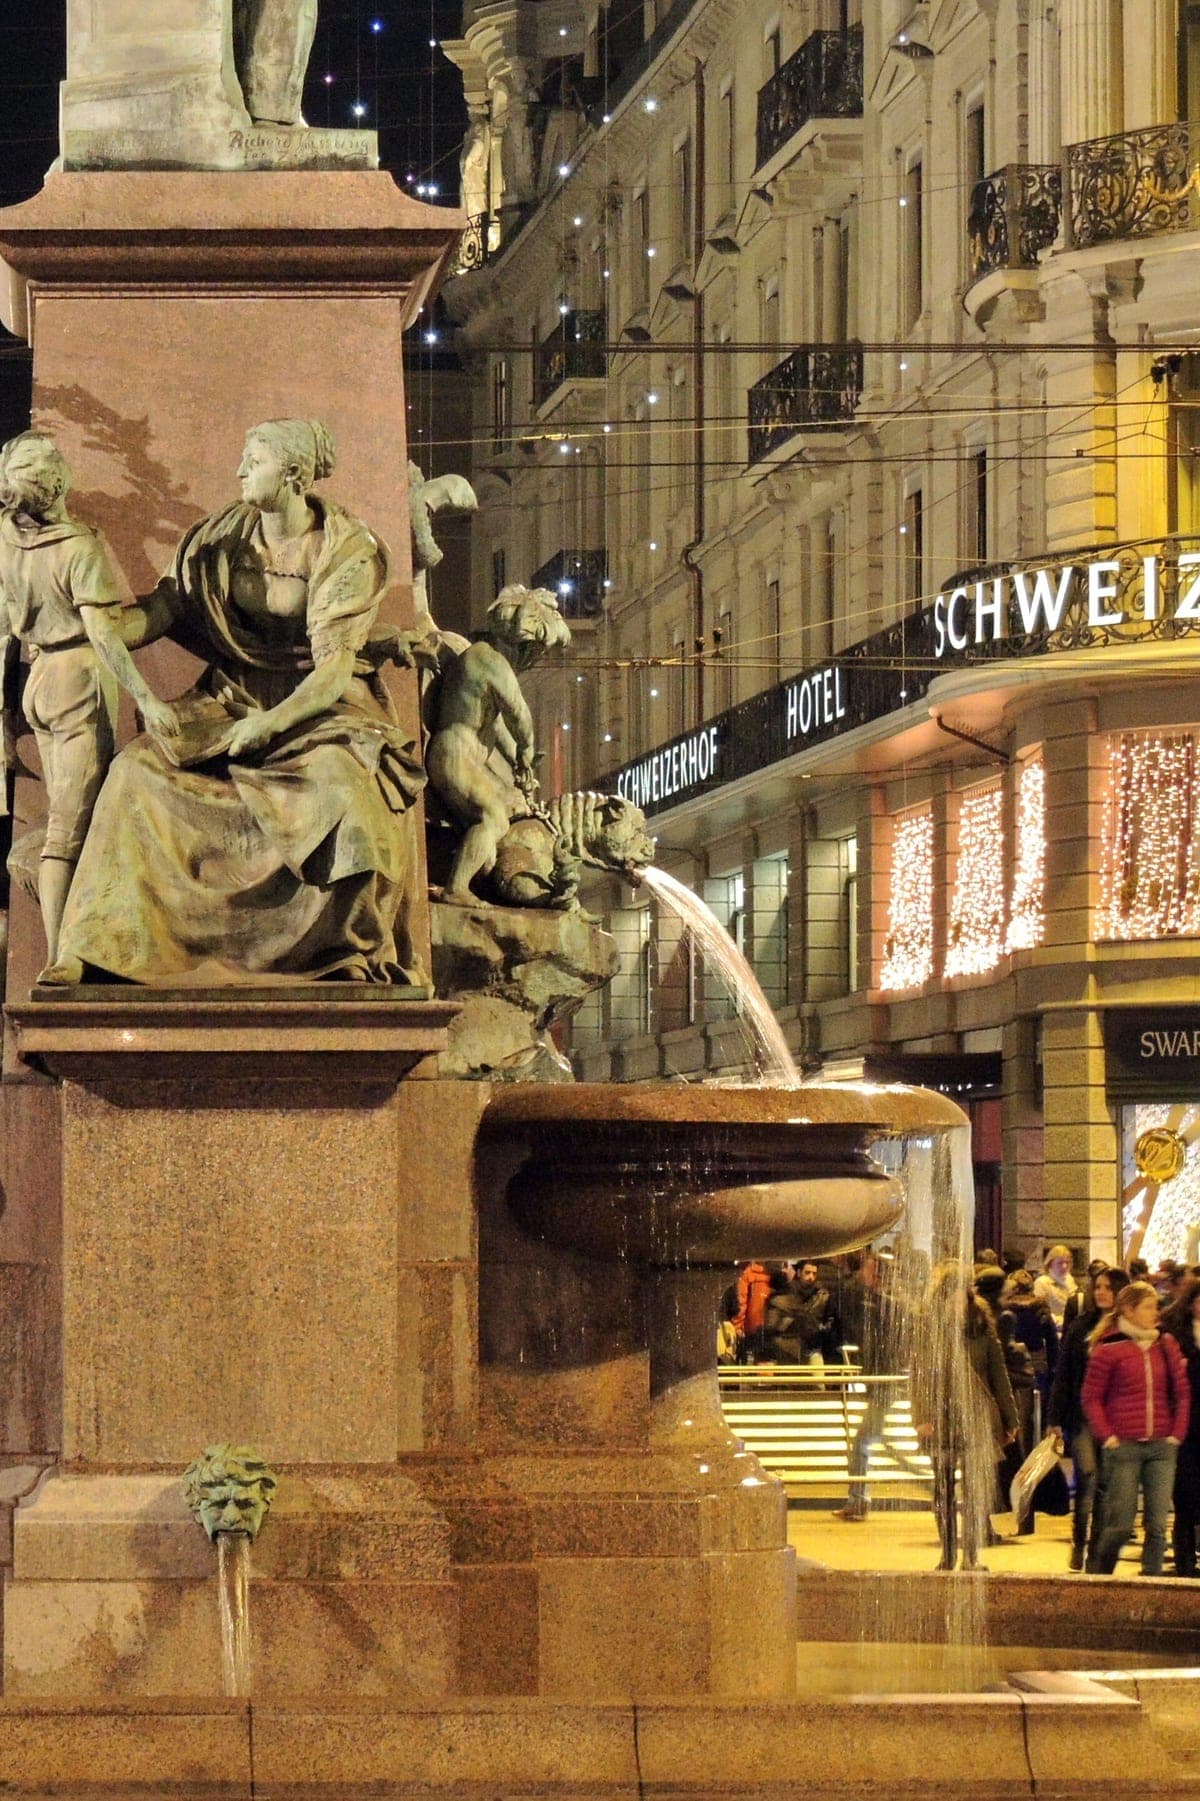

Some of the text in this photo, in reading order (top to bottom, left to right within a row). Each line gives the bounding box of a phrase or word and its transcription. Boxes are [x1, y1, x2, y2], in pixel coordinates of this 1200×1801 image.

[934, 553, 1200, 658] SCHWEIZ
[618, 666, 845, 809] SCHWEIZERHOF HOTEL
